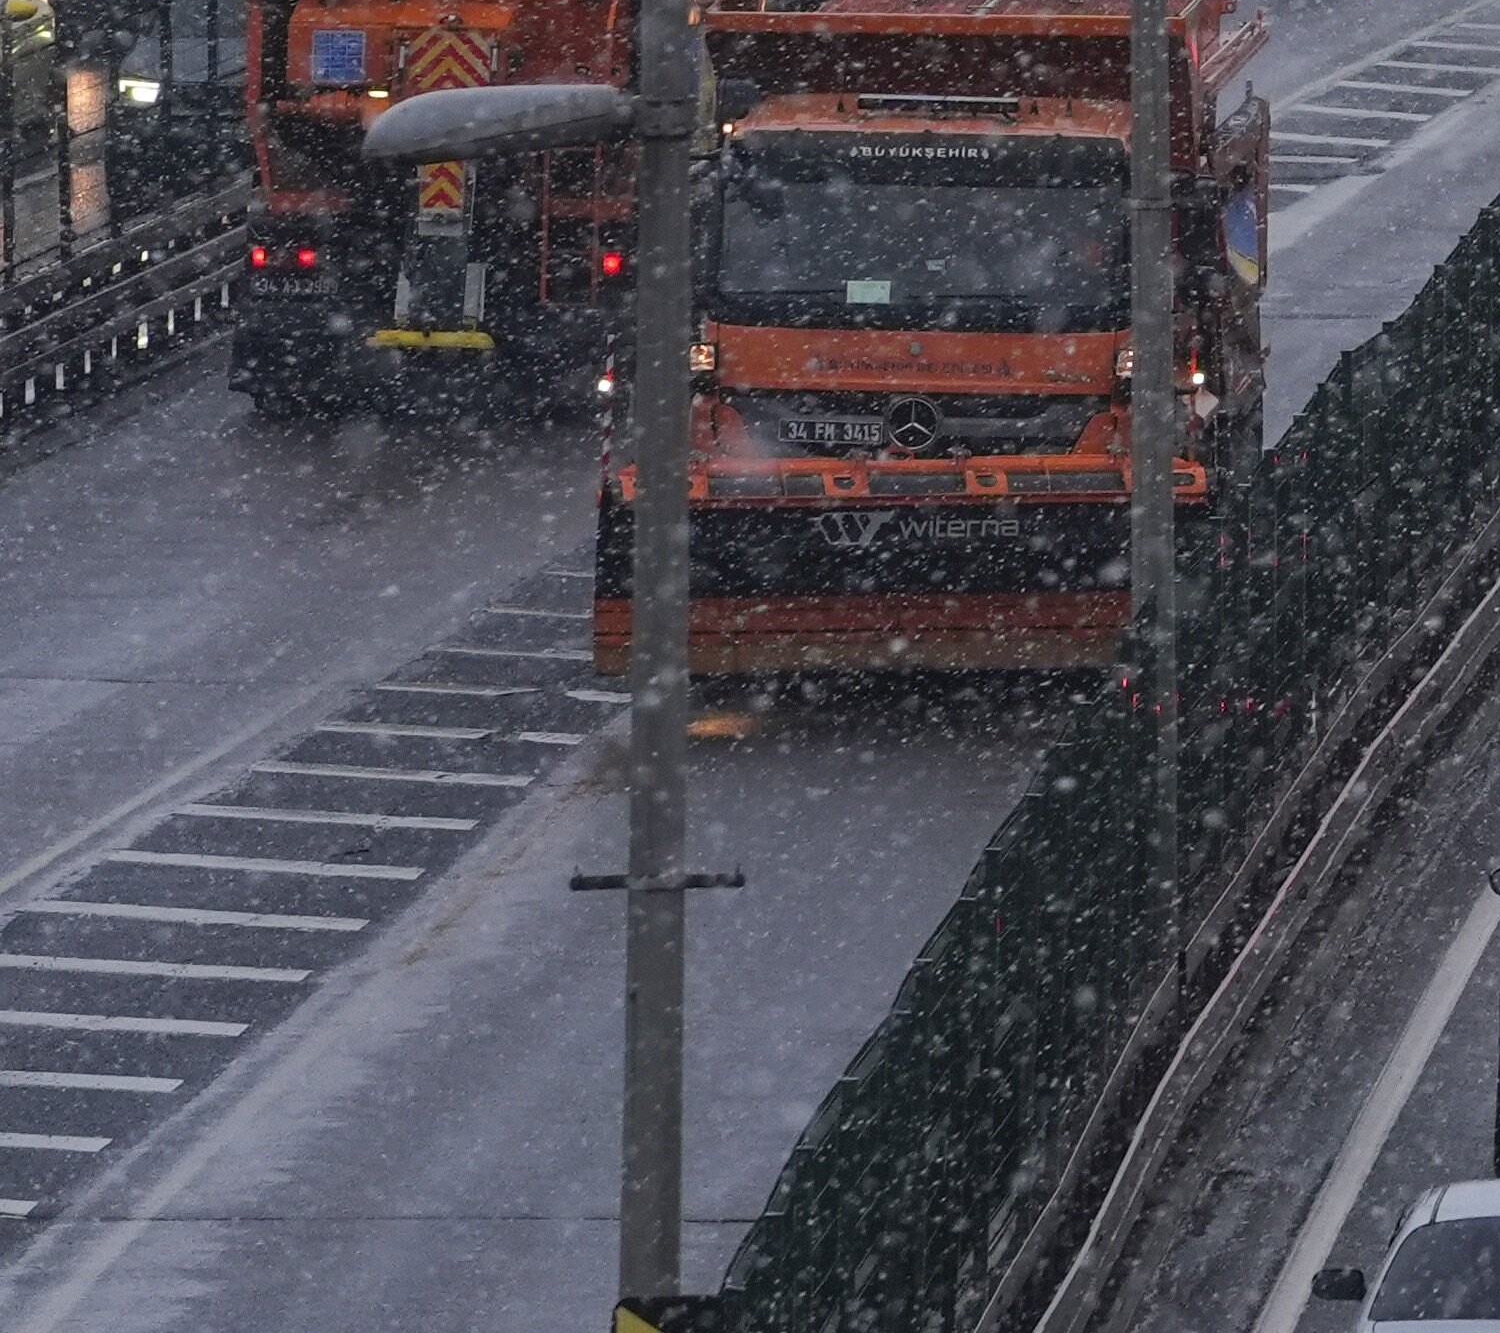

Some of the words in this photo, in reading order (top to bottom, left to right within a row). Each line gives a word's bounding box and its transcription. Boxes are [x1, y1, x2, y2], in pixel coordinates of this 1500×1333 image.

[788, 422, 808, 439] 34
[843, 424, 880, 441] 3415
[899, 516, 1019, 539] witerna
